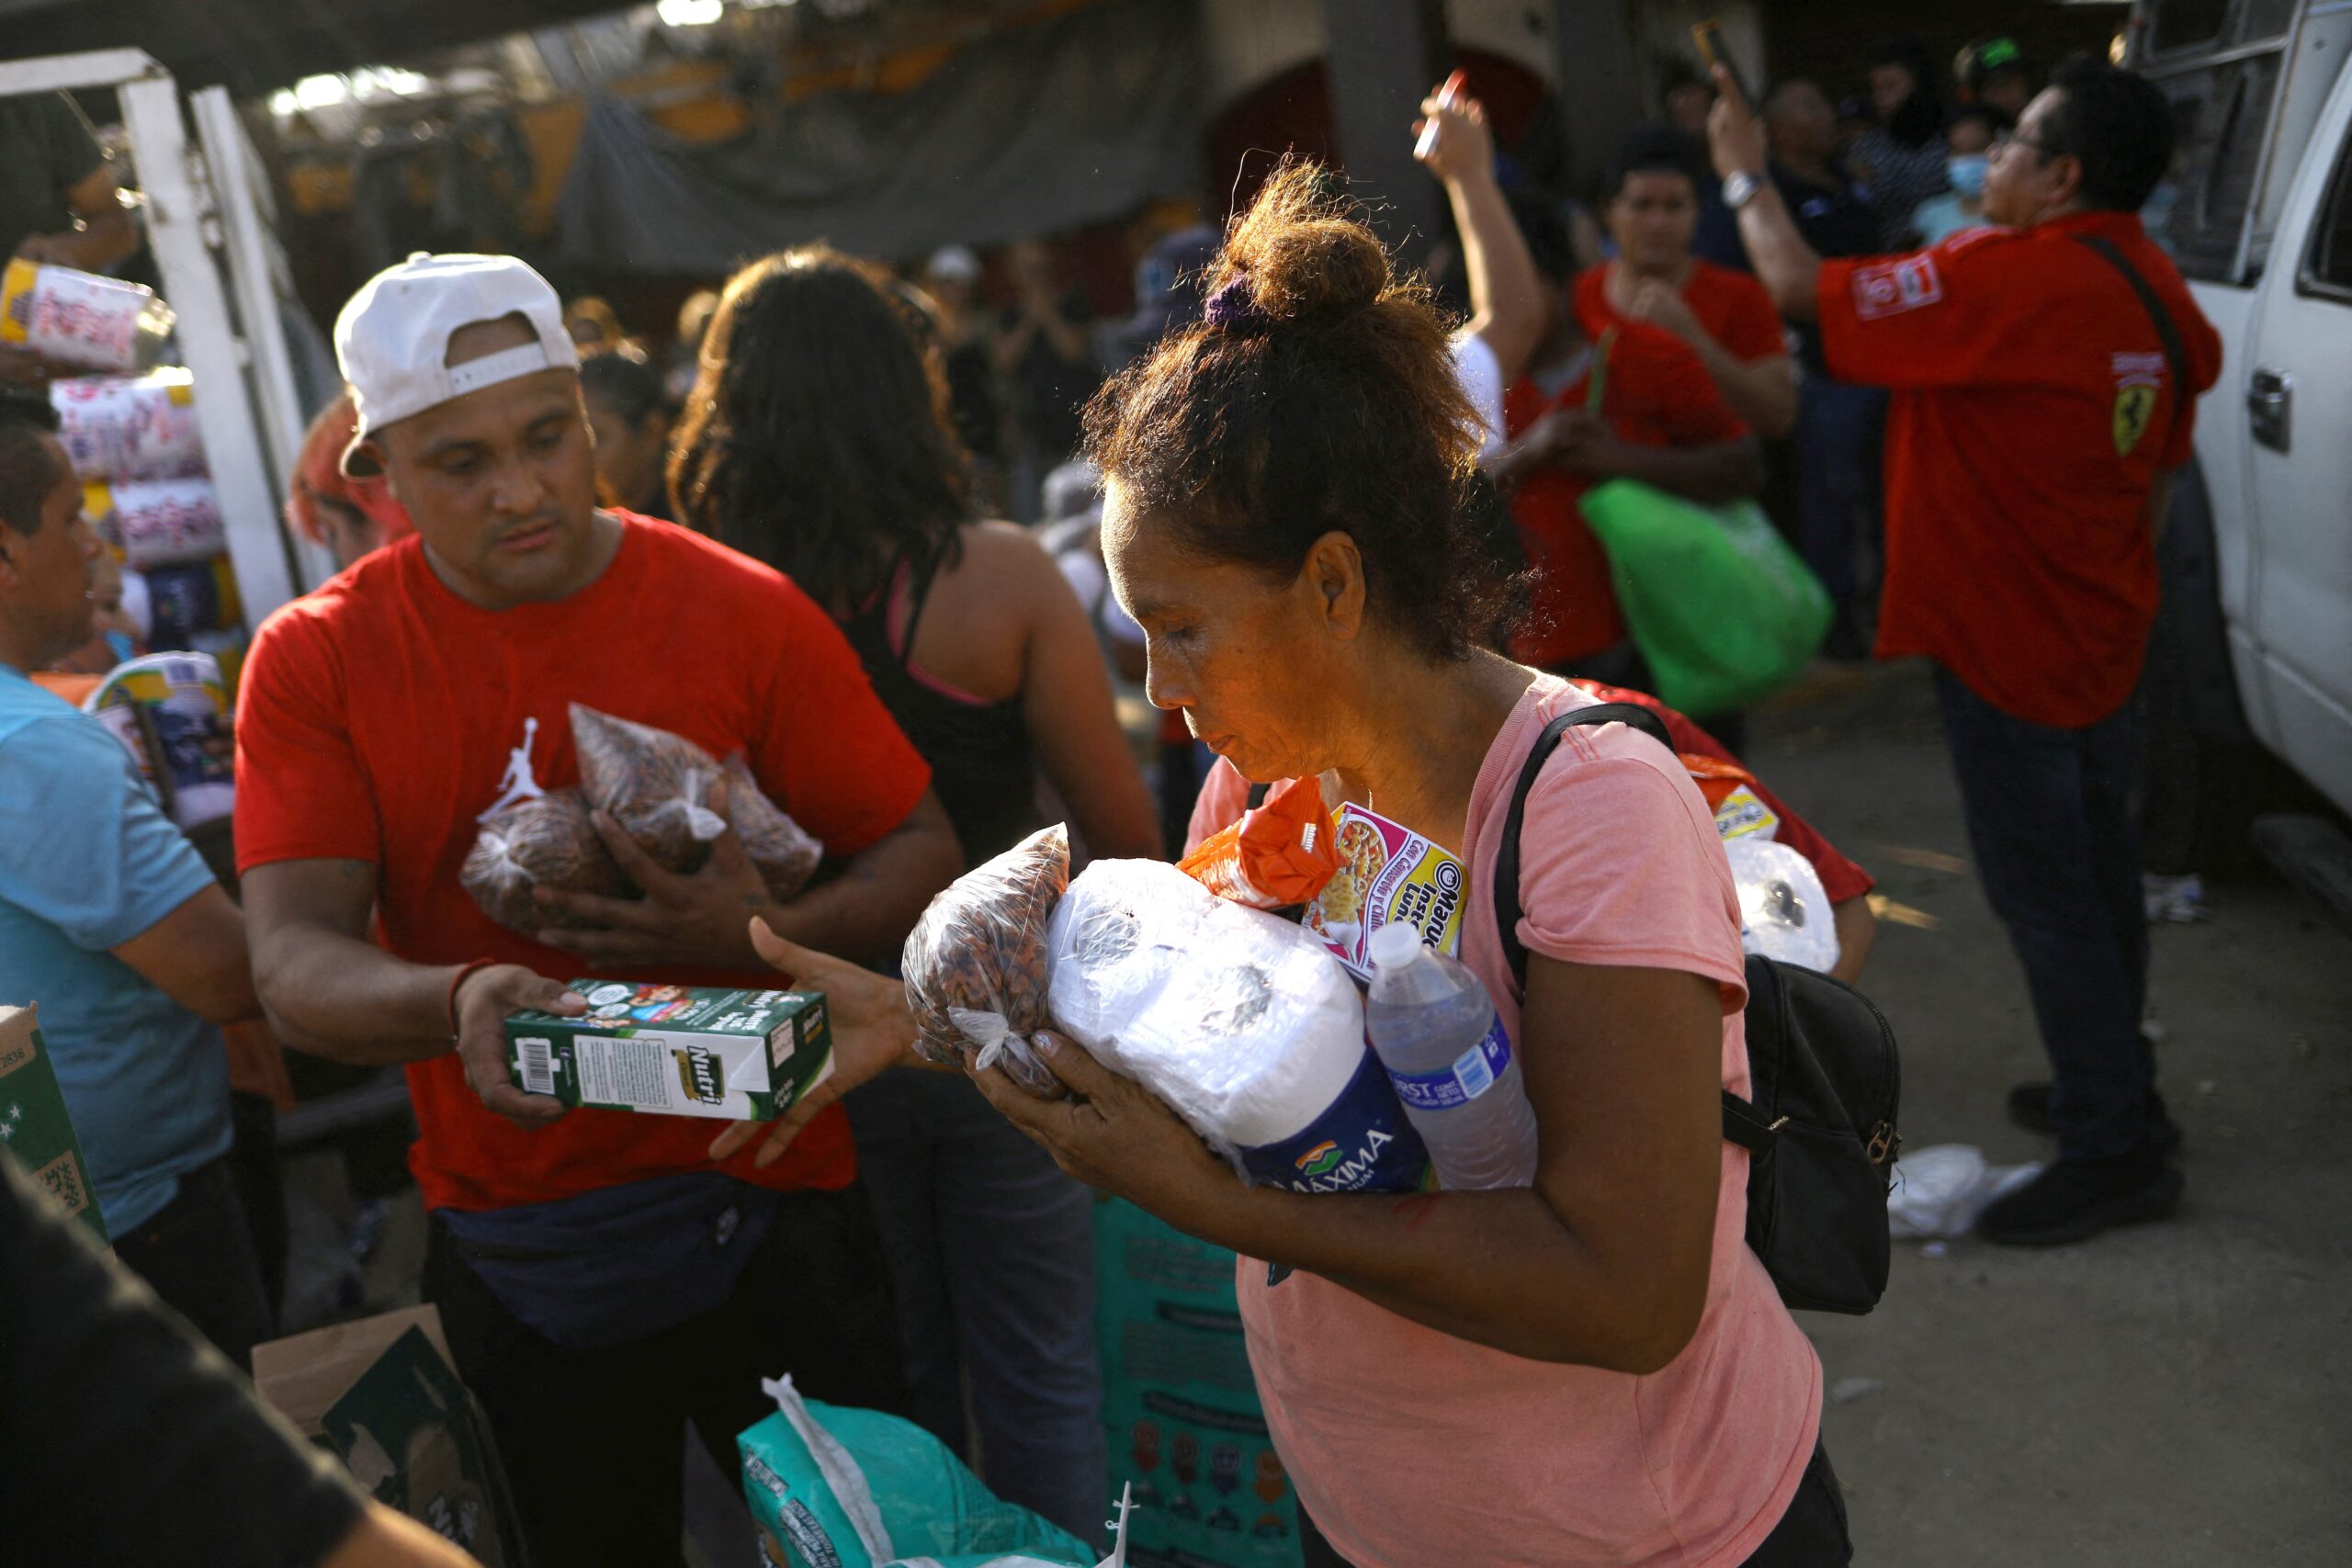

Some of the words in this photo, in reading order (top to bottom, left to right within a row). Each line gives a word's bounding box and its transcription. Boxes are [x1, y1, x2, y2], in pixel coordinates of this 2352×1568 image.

[1406, 840, 1425, 861] Con
[0, 1047, 25, 1070] 2838
[687, 1045, 722, 1105] Nutri
